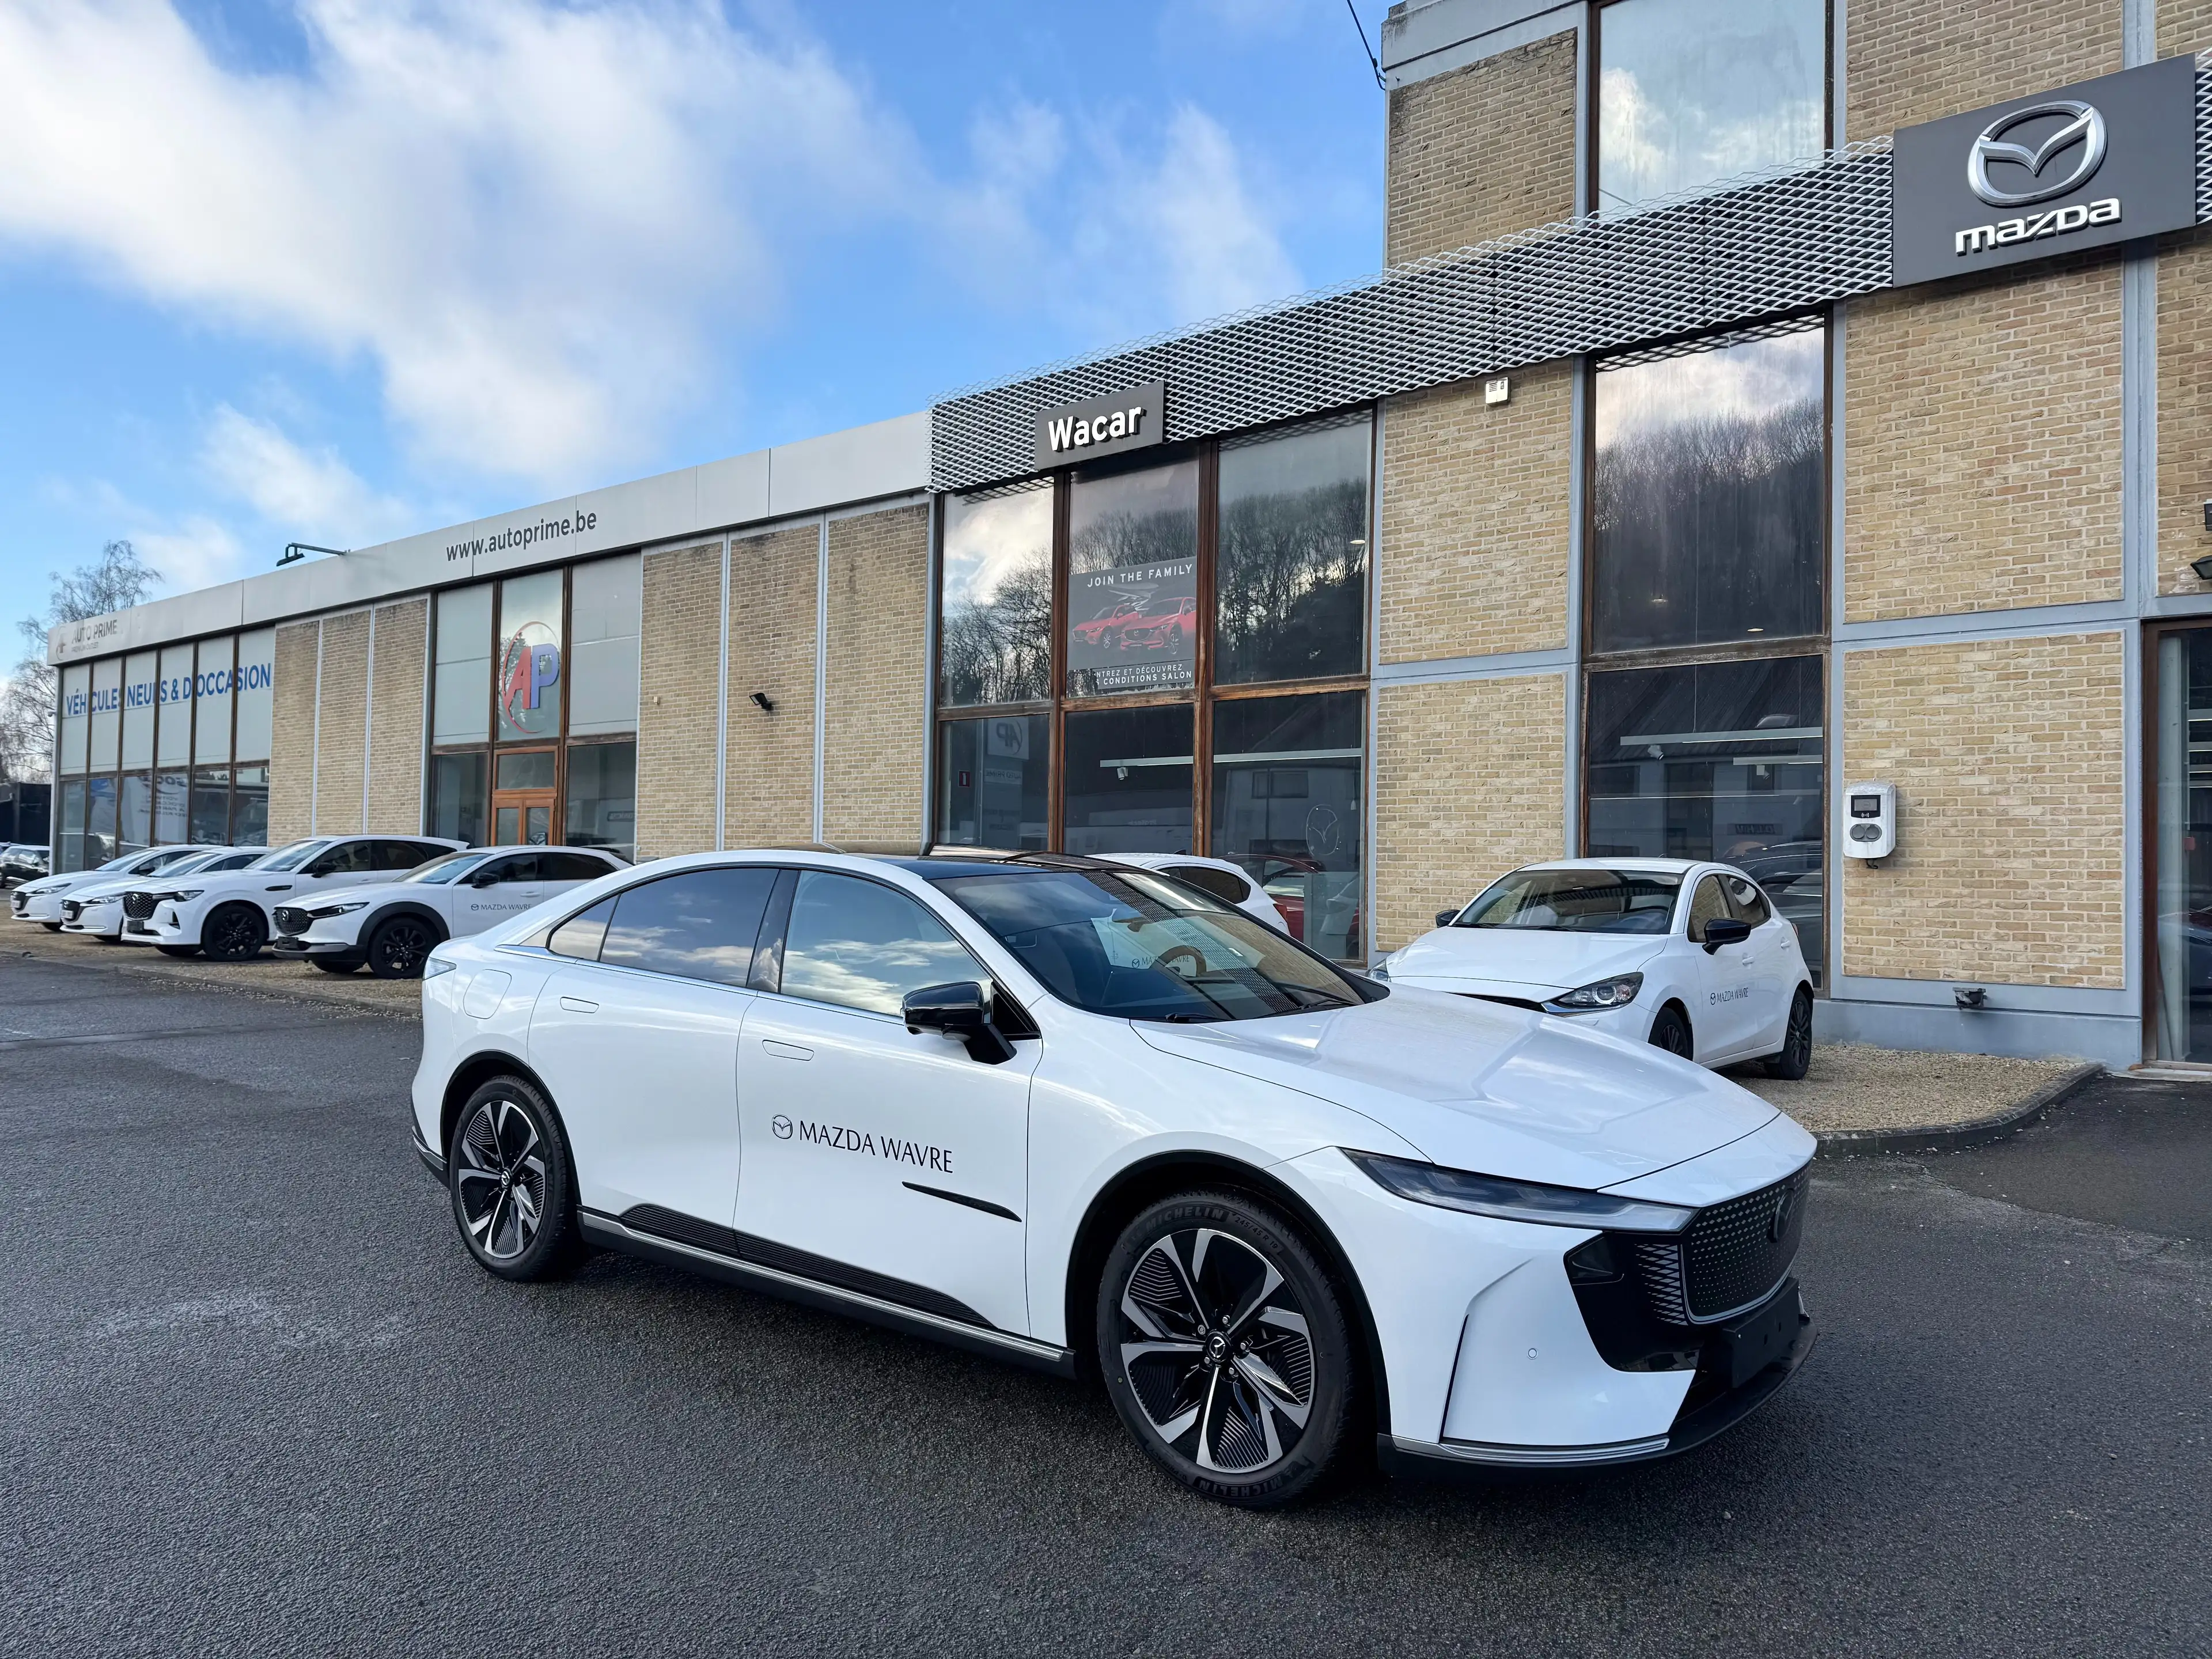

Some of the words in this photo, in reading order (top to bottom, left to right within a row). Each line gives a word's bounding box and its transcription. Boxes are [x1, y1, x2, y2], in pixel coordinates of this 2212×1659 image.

[1955, 198, 2122, 256] mazda
[1048, 406, 1144, 452] Wacar
[446, 510, 597, 562] www.autoprime.be
[1087, 575, 1114, 588] JOIN
[1120, 571, 1142, 583] THE
[1149, 563, 1192, 579] FAMILY
[71, 626, 92, 644] AUTO
[93, 619, 118, 639] PRIME
[503, 643, 559, 710] AP
[1095, 669, 1120, 678] NTREZ
[1136, 664, 1183, 675] DÉCOUVREZ
[1103, 673, 1157, 685] CONDITIONS
[1161, 671, 1192, 681] SALON
[171, 678, 179, 701] &
[1717, 990, 1734, 1003] MAZDA
[1734, 987, 1748, 999] WAVRE
[800, 1120, 876, 1156] MAZDA
[880, 1135, 953, 1173] WAVRE
[1146, 1206, 1223, 1229] MICHELIN
[1234, 1217, 1262, 1237] 245/45
[1270, 1241, 1278, 1249] 19
[1199, 1475, 1283, 1497] MICHELIN
